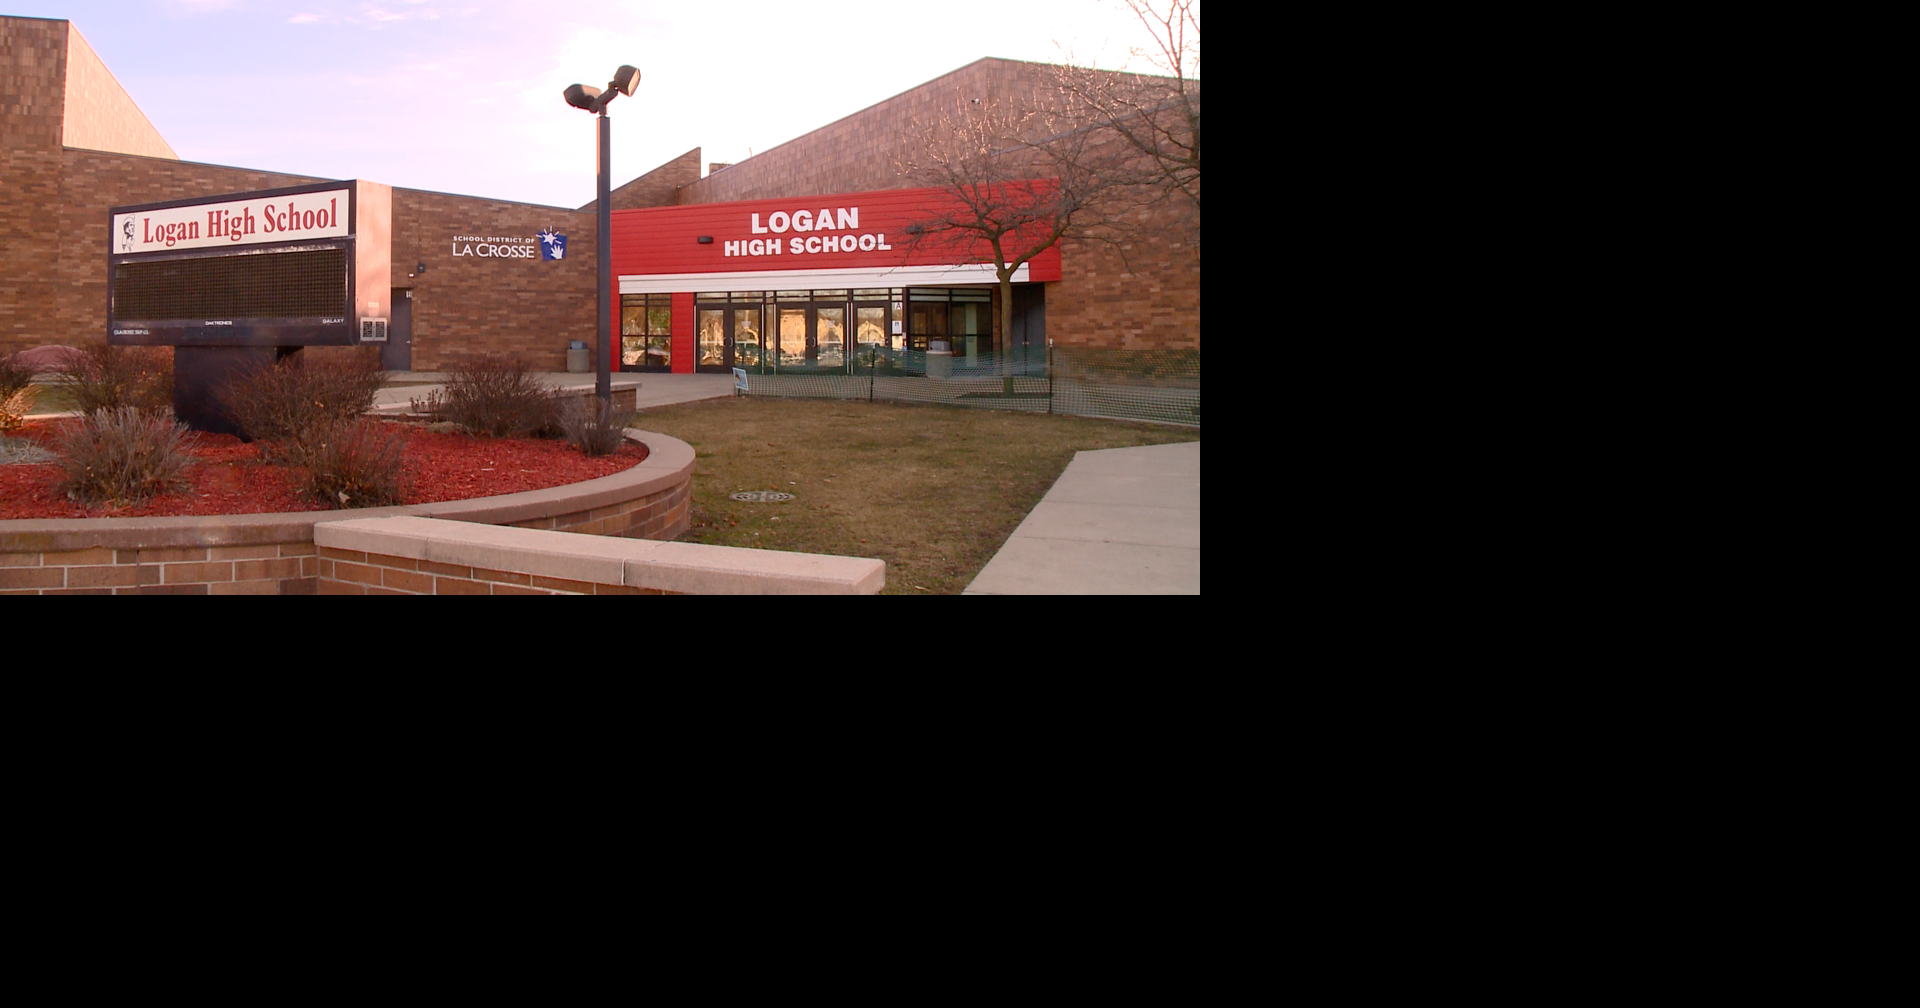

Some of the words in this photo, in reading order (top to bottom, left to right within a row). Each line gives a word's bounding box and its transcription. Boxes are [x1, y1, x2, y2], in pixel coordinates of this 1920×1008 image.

[142, 217, 200, 247] Logan
[207, 206, 256, 241] High
[263, 197, 337, 233] School
[751, 207, 859, 234] LOGAN
[452, 242, 474, 257] LA
[475, 243, 535, 258] CROSSE
[724, 238, 782, 257] HIGH
[789, 233, 892, 254] SCHOOL
